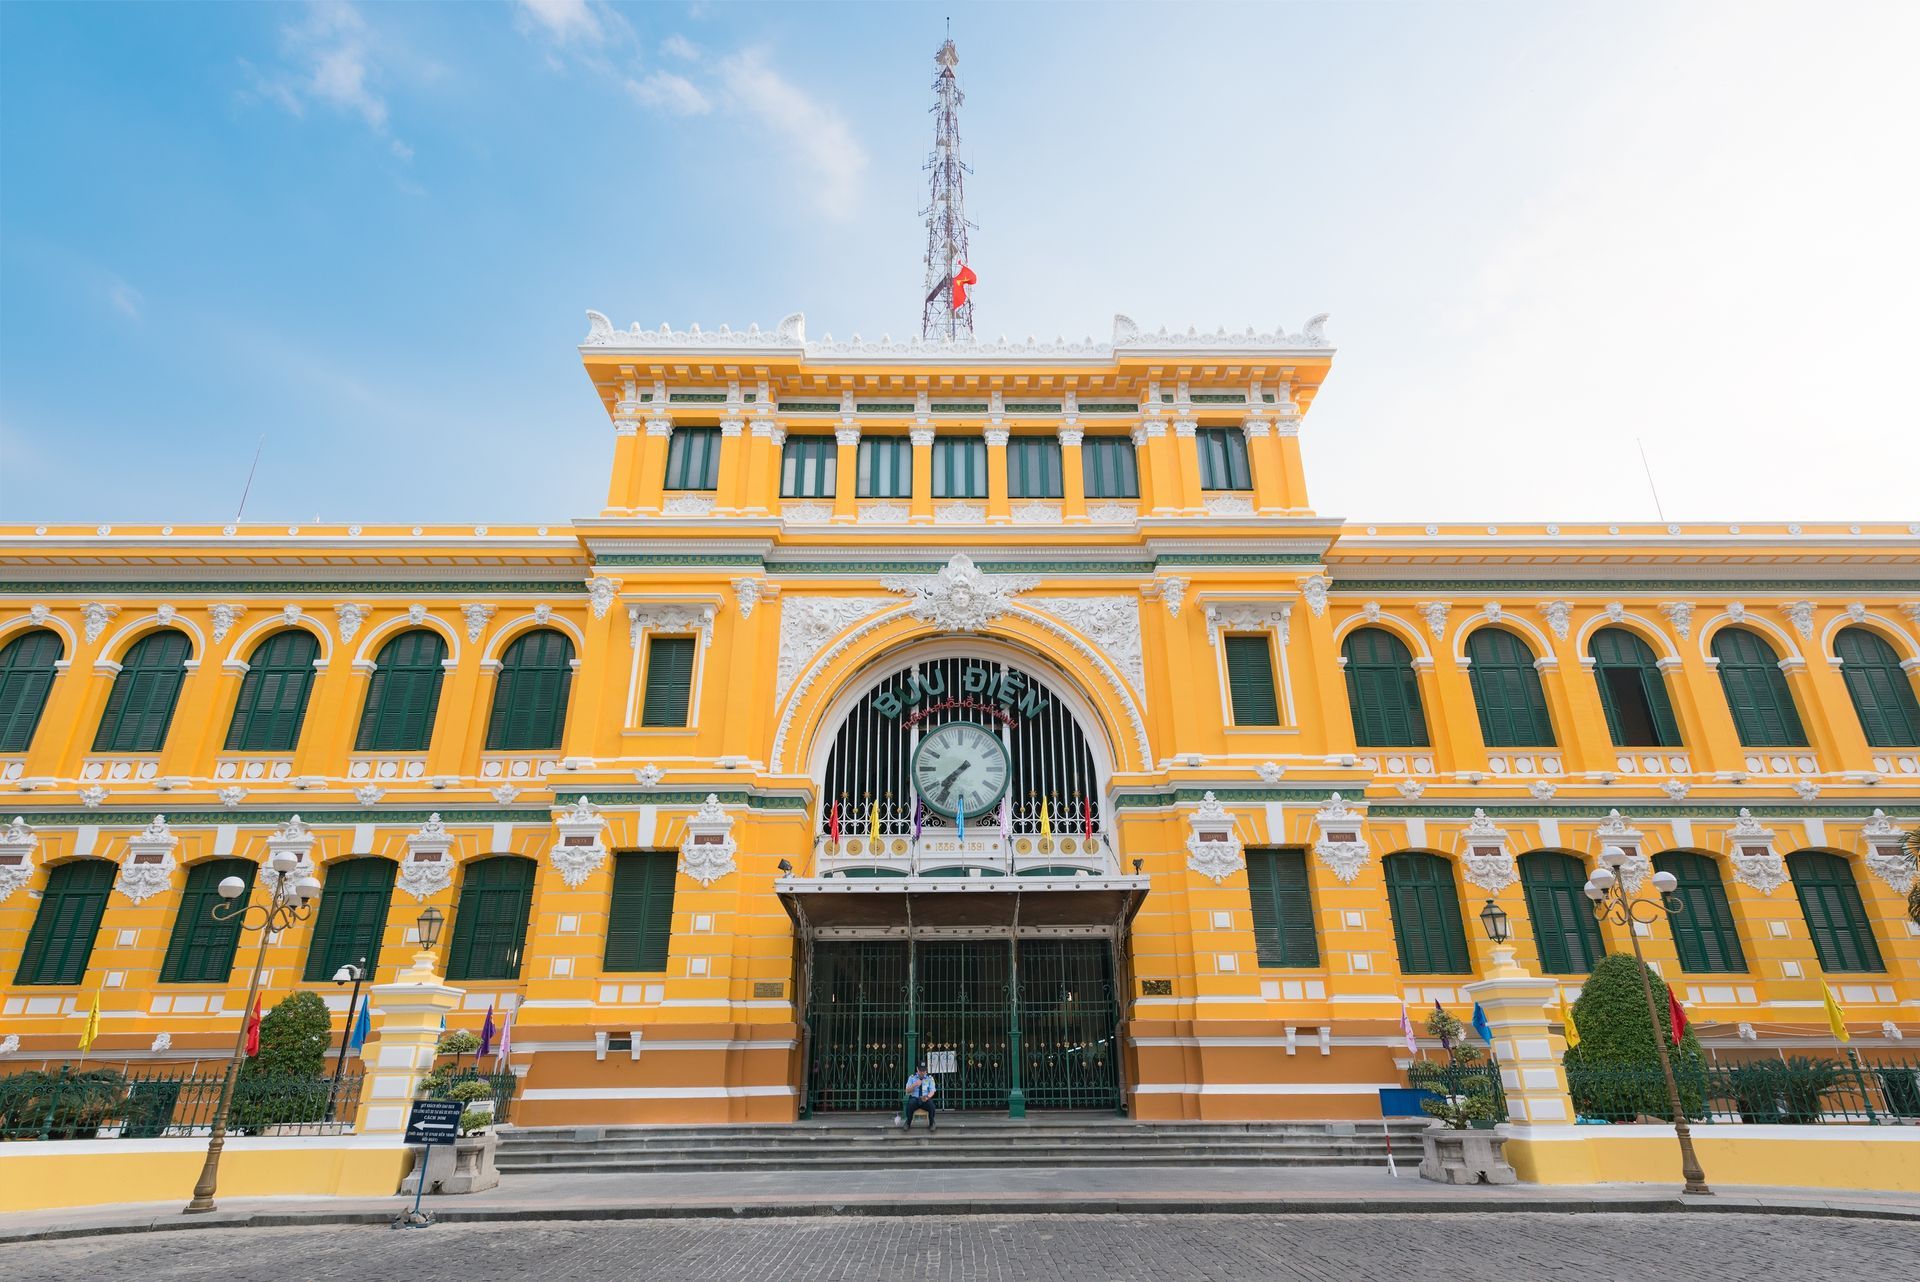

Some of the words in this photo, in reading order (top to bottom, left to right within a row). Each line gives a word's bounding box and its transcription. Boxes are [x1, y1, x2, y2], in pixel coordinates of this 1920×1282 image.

[963, 666, 1049, 719] ĐIỆN
[935, 842, 955, 851] 1886
[968, 842, 985, 851] 1891
